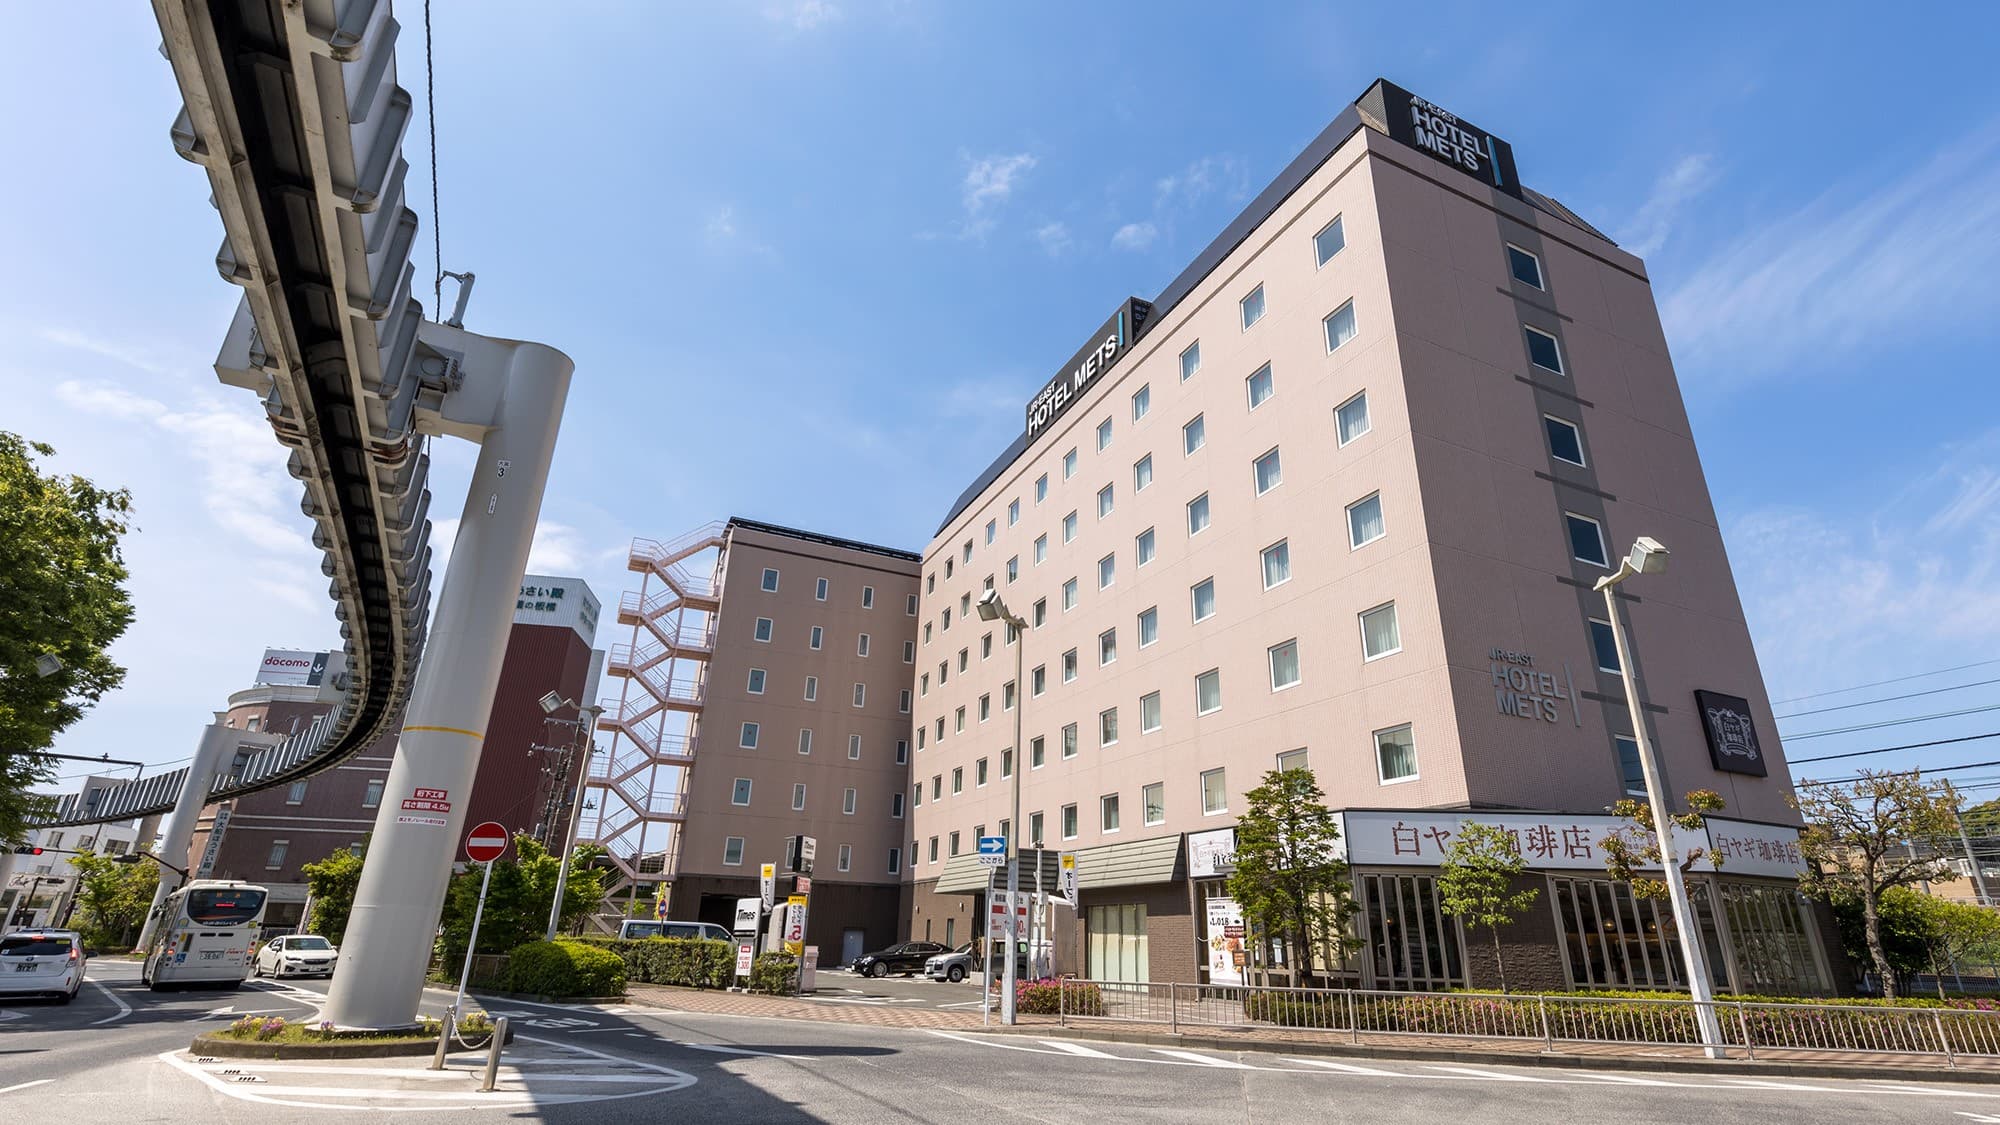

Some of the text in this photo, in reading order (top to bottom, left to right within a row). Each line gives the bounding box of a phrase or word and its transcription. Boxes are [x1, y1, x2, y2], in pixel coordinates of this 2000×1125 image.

[1411, 105, 1488, 160] HOTEL
[1415, 126, 1479, 171] METS
[1028, 334, 1118, 436] HOTEL METS
[497, 467, 505, 477] 3
[264, 656, 310, 668] docomo
[1490, 661, 1568, 700] HOTEL
[1496, 689, 1558, 723] METS
[1715, 832, 1800, 865] 白ヤギ珈琲店
[737, 909, 756, 921] Times
